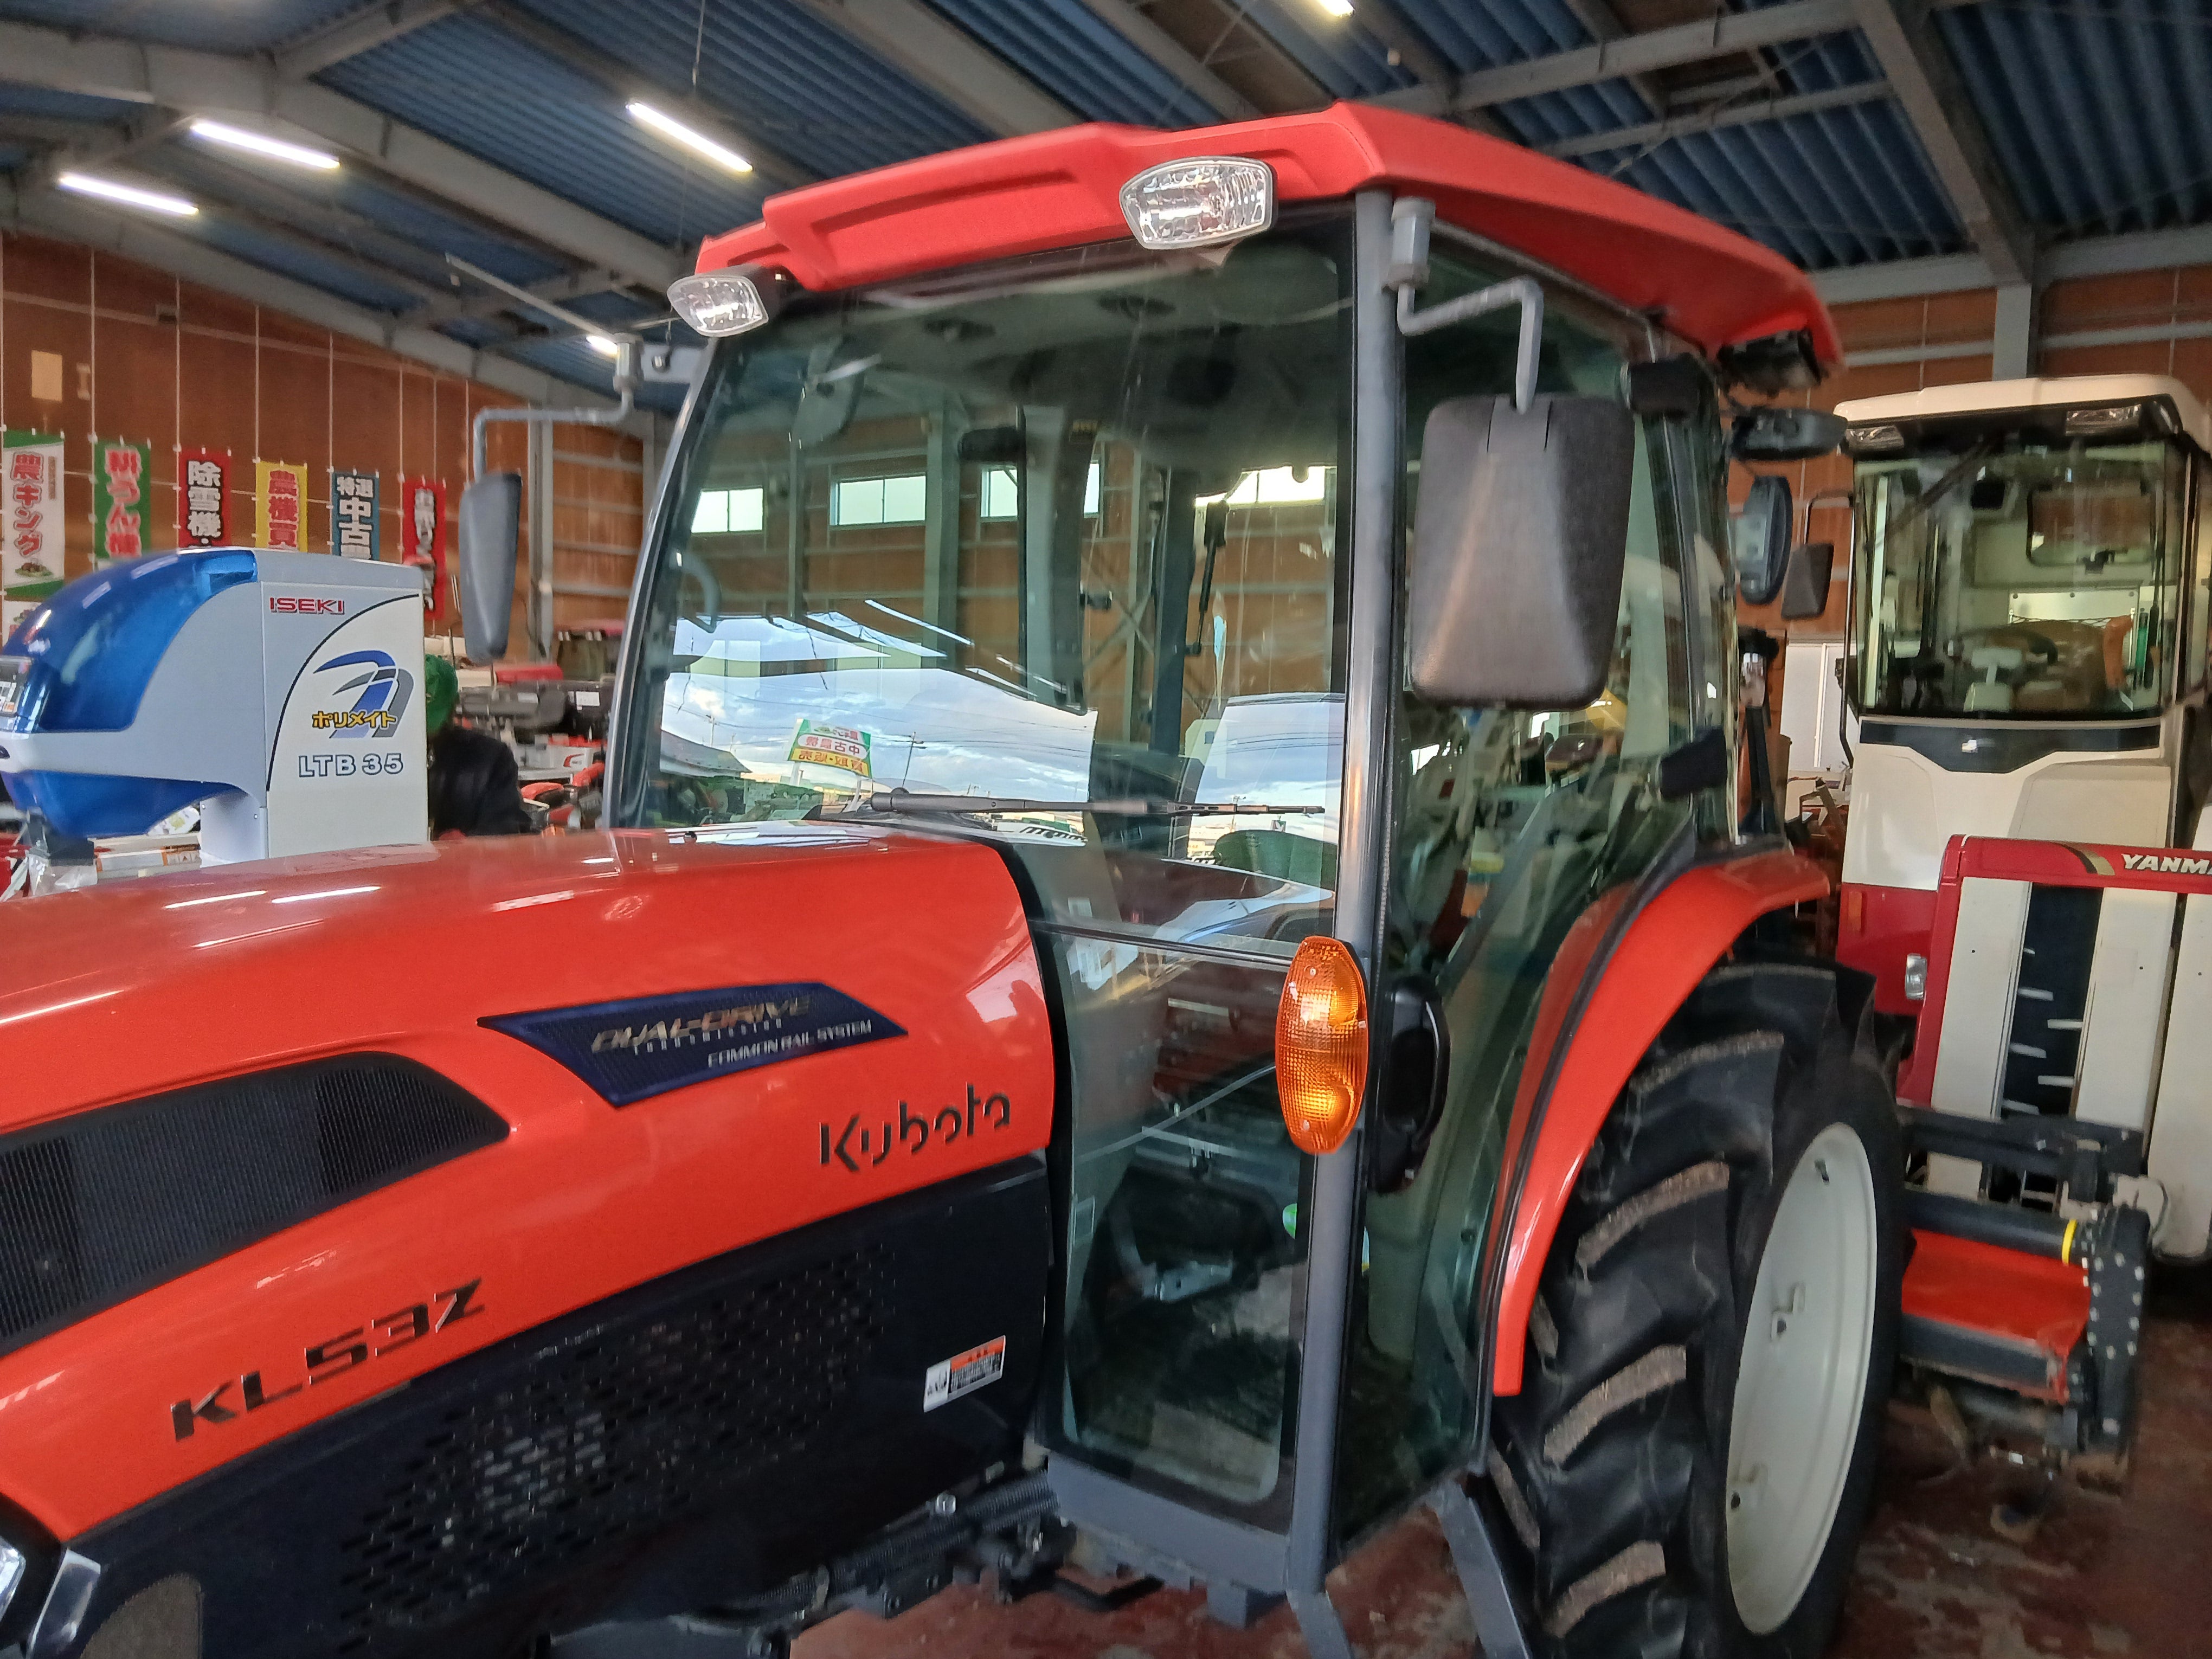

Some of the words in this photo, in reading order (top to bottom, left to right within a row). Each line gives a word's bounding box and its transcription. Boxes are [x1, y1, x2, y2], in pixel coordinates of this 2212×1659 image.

[11, 451, 43, 557] 農キング
[187, 460, 222, 548] 除雪機・
[268, 470, 298, 549] 農機買
[269, 597, 344, 615] ISEKI
[312, 711, 396, 728] ポリメイト
[299, 754, 356, 777] LTB
[362, 753, 403, 775] 35
[2121, 853, 2212, 875] YANM
[591, 996, 811, 1053] DUAL-DRIVE
[708, 1037, 778, 1068] COMMON
[781, 1032, 809, 1051] RAIL
[817, 1019, 871, 1041] SYSTEM
[819, 1081, 1011, 1172] Kubota
[170, 1277, 485, 1442] KL53Z
